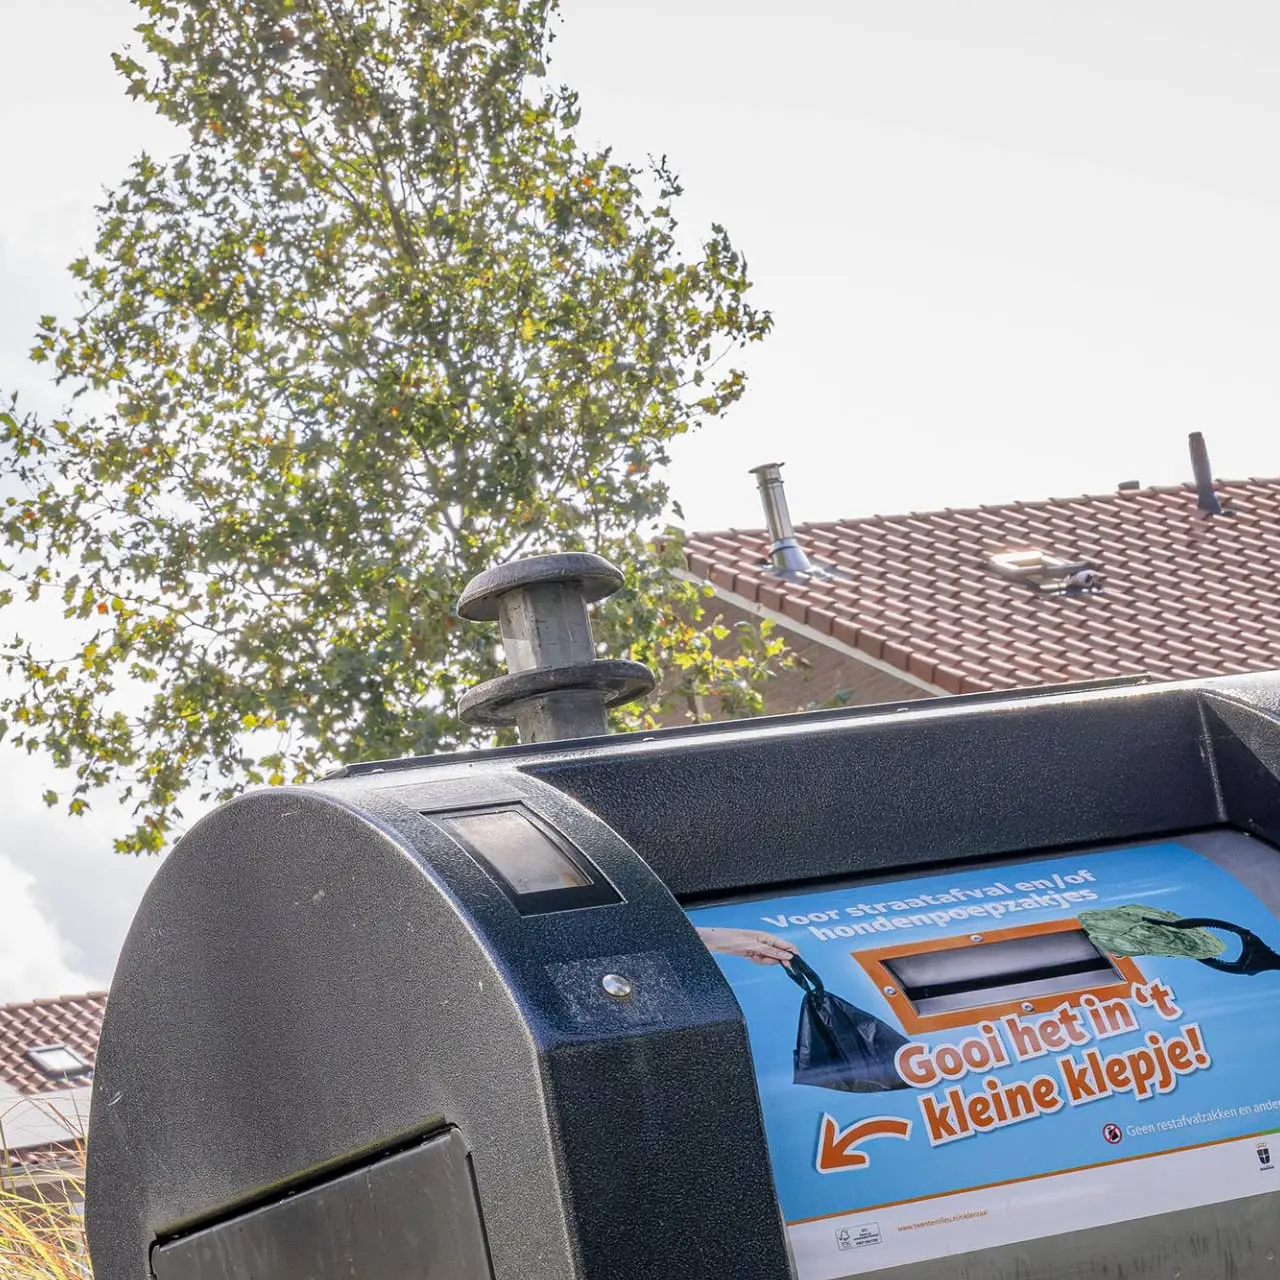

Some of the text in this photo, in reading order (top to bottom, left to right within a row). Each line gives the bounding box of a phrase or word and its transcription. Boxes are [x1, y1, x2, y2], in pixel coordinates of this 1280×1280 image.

[760, 869, 1097, 929] Voor straatafval en/of
[807, 887, 1099, 942] hondenpoepzakjes
[897, 1022, 1007, 1086] Gooi
[1004, 1005, 1086, 1058] het
[1083, 995, 1135, 1037] in
[920, 1026, 1209, 1142] kleine klepje!
[1127, 1122, 1156, 1137] Geen
[1156, 1106, 1238, 1131] restafvalzakken
[1239, 1104, 1252, 1115] en
